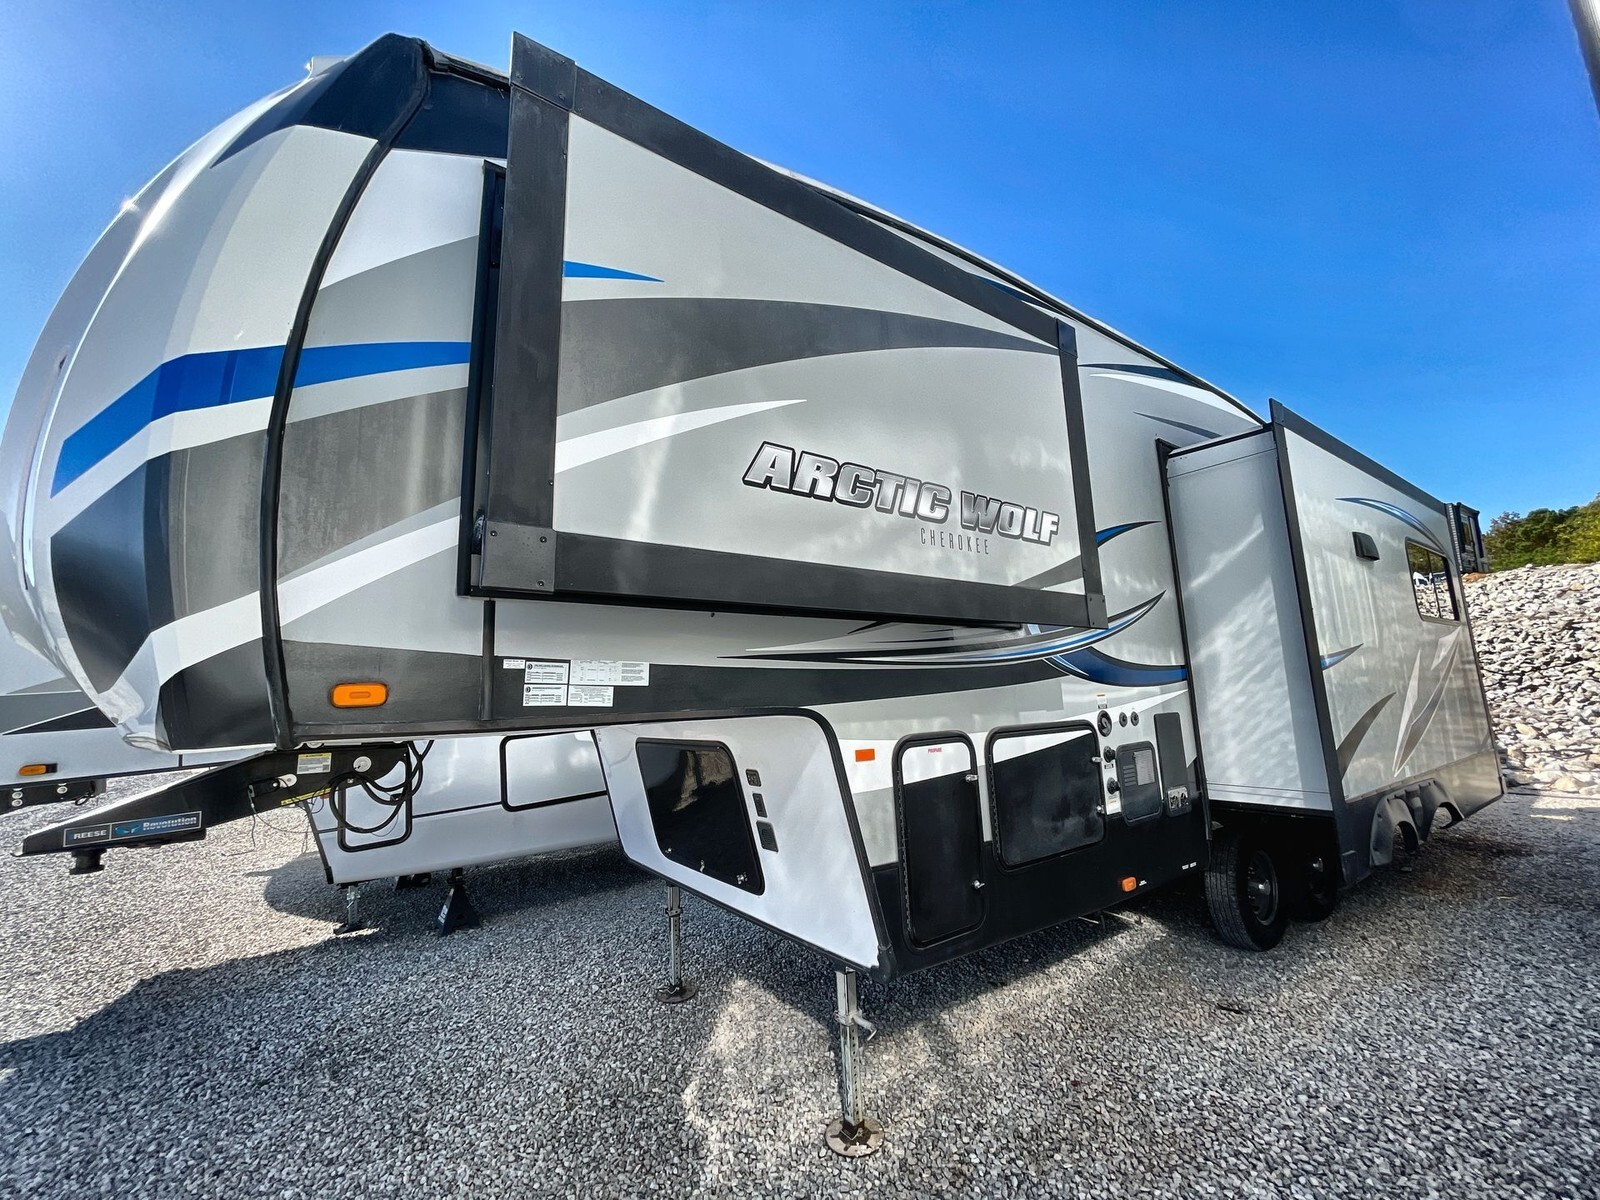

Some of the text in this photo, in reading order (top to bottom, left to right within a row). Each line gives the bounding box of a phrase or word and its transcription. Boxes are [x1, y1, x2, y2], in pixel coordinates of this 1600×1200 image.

[742, 441, 1060, 546] ARCTIC WOLF
[920, 527, 990, 555] CHEROKEE
[142, 816, 197, 831] Revolution
[73, 829, 108, 840] REESE
